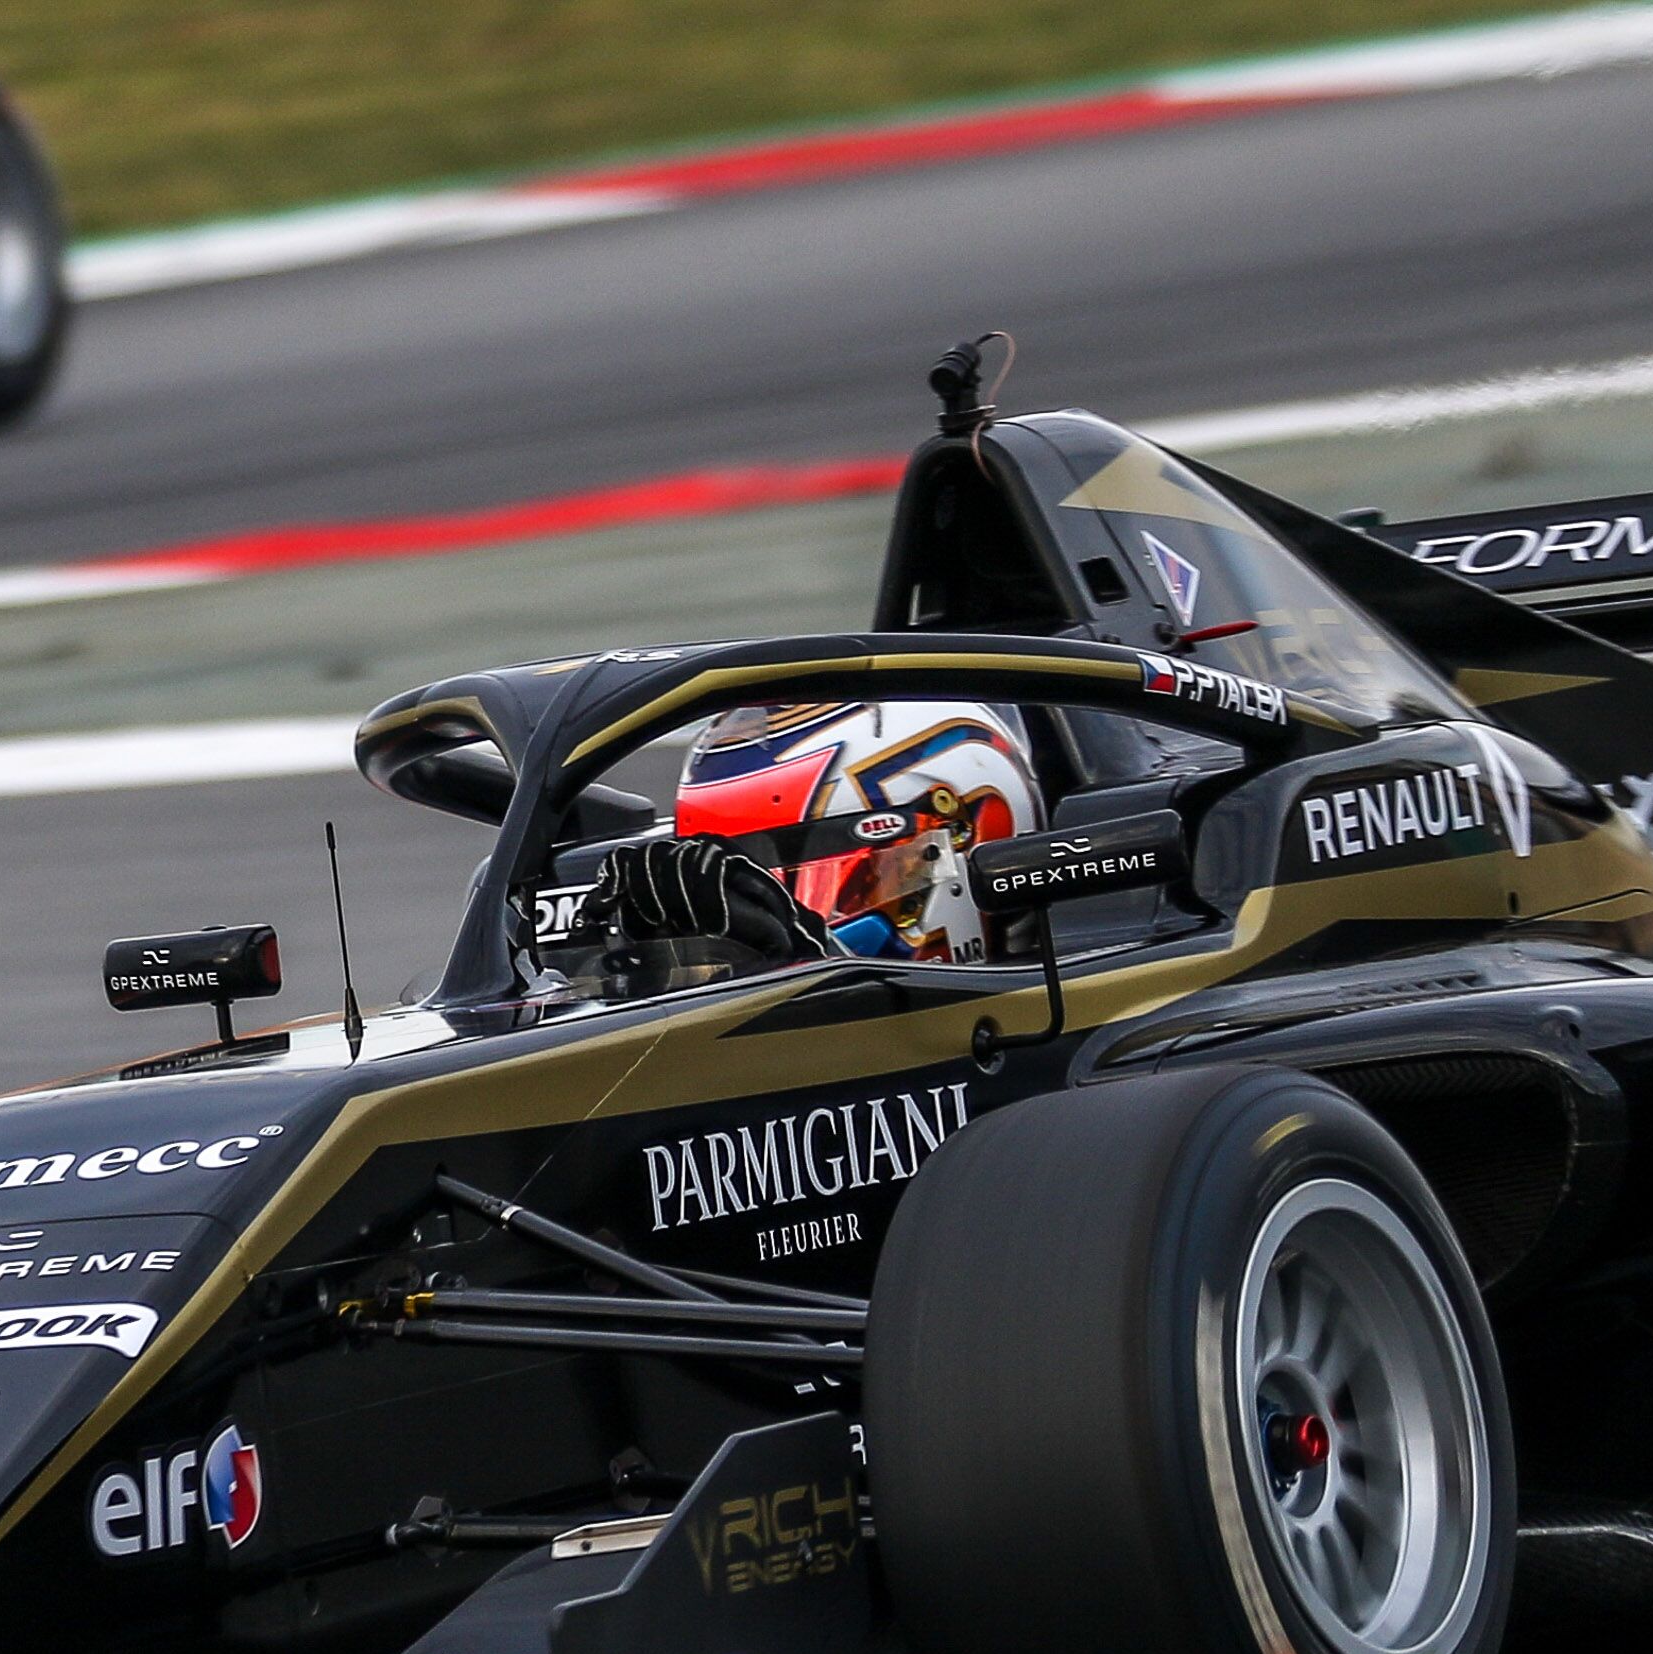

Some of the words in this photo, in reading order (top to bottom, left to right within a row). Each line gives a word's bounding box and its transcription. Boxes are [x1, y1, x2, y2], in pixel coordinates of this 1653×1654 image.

[861, 817, 902, 834] BELL
[1302, 763, 1486, 863] RENAULT
[992, 851, 1158, 893] GPEXTREME
[110, 972, 220, 991] GPEXTREME
[642, 1082, 968, 1232] PARMIGIANI
[756, 1213, 863, 1261] FLEURIER
[92, 1450, 196, 1556] elf
